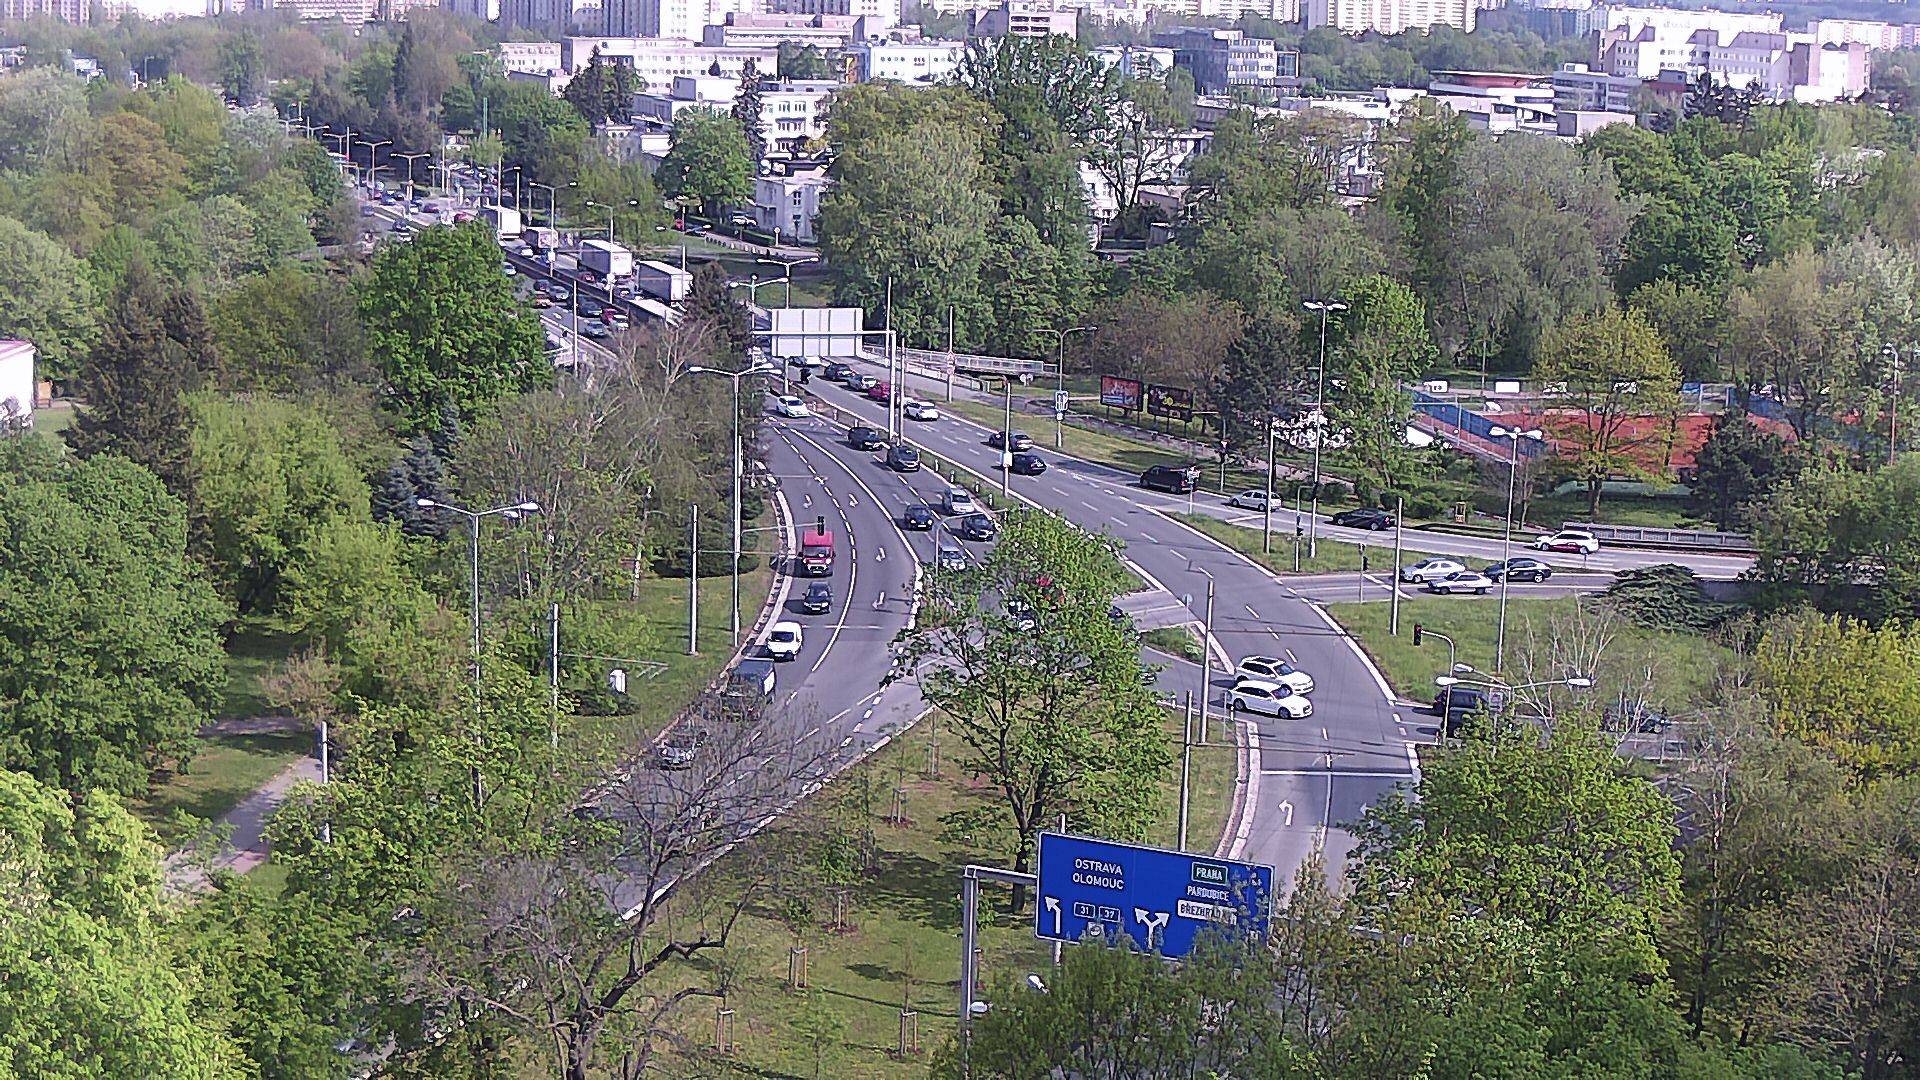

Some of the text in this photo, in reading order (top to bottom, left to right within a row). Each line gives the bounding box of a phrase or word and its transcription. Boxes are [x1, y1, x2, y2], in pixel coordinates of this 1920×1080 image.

[1075, 858, 1123, 876] OSTRAVA
[1196, 867, 1223, 880] PRAHA
[1072, 872, 1125, 890] OLOMOUC
[1080, 905, 1089, 915] 31
